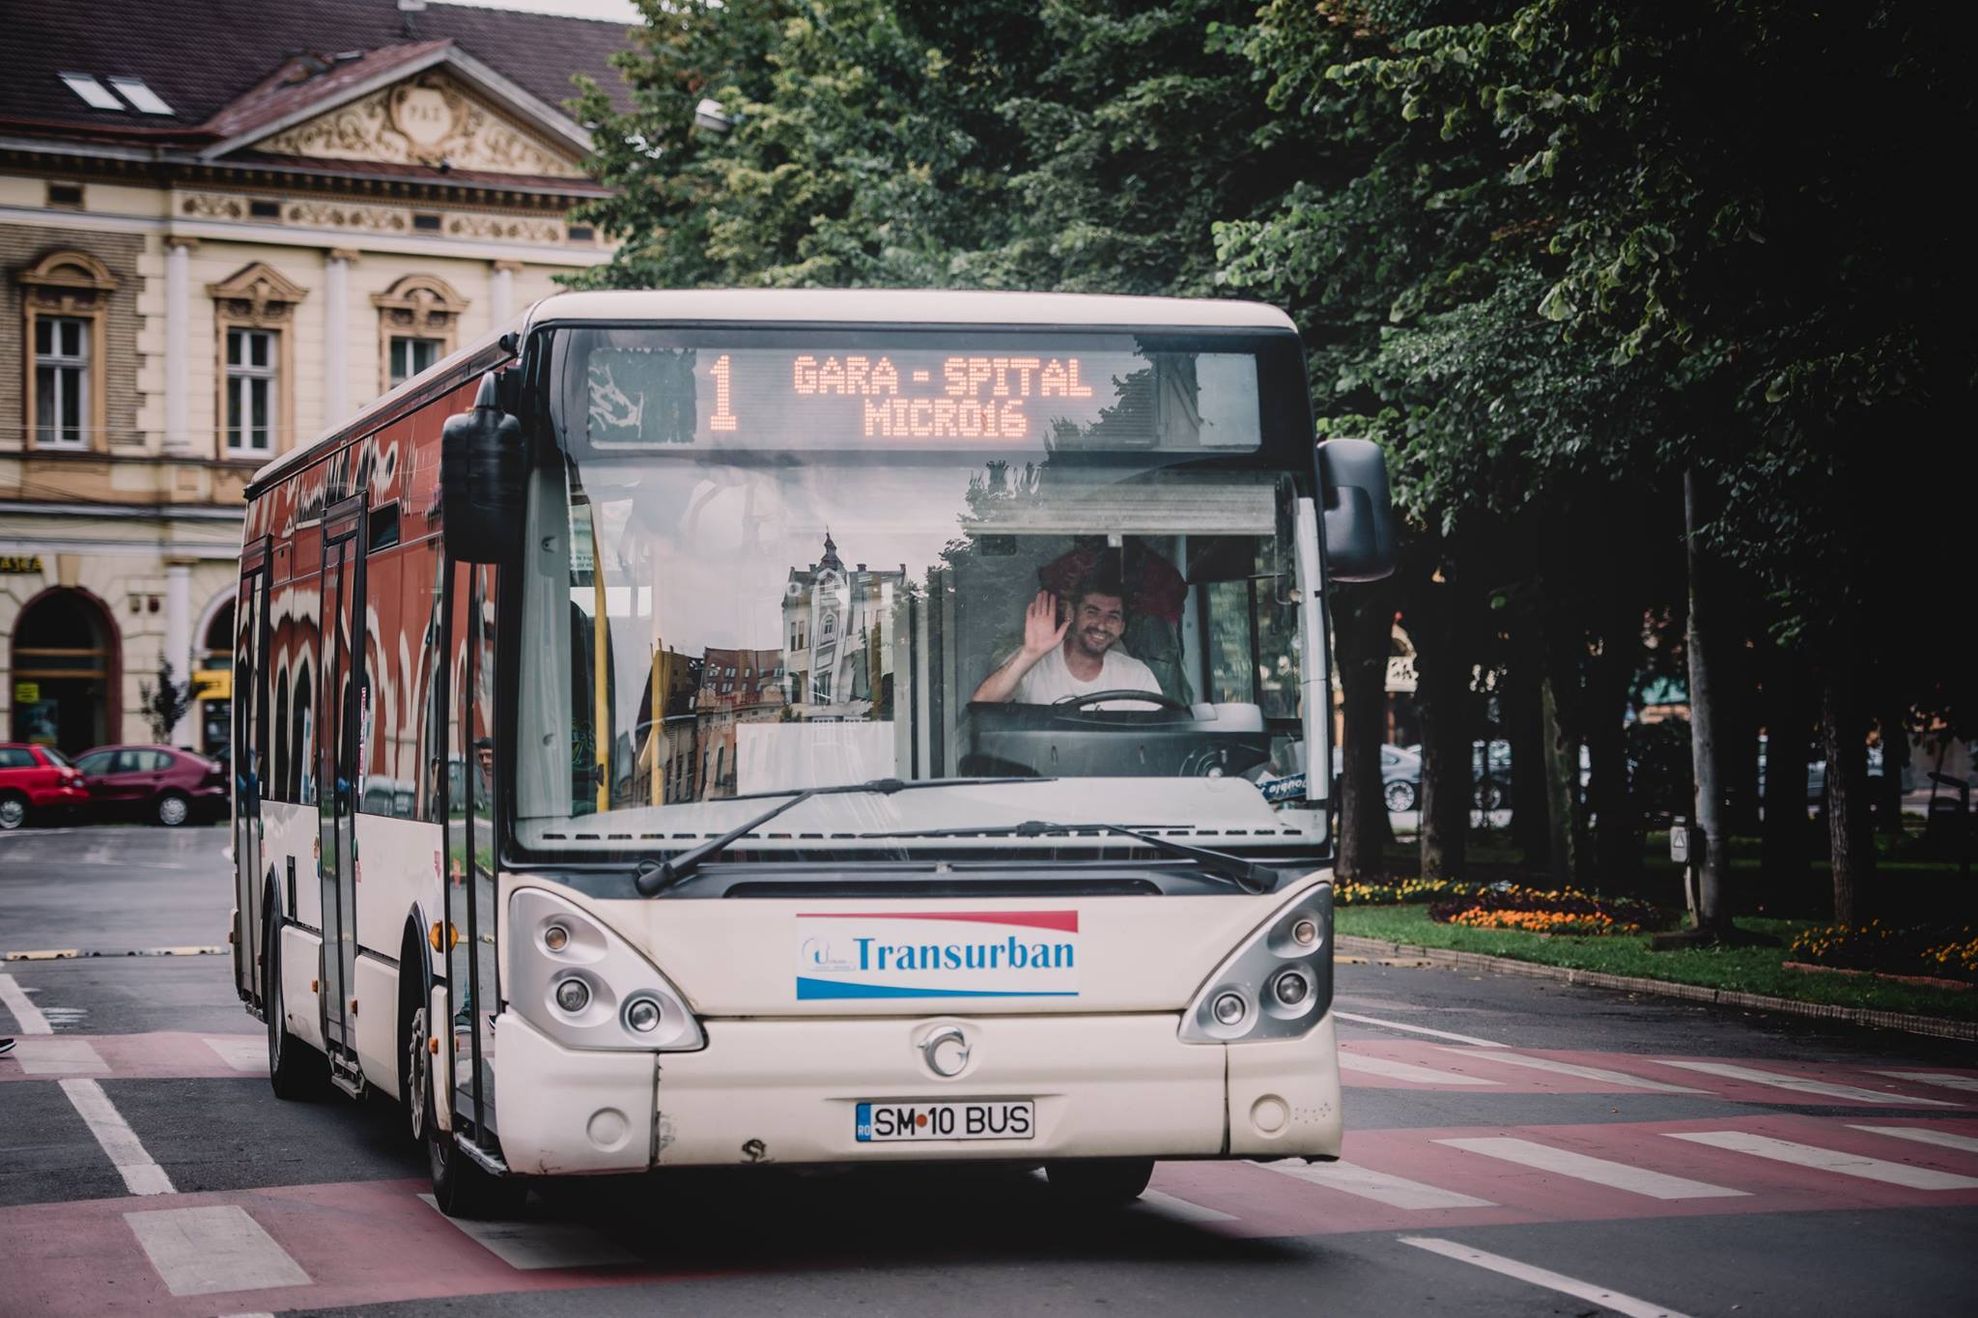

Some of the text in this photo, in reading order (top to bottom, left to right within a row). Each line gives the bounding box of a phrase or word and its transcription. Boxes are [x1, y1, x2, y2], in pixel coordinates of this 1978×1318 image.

[709, 354, 737, 432] 1
[794, 356, 1092, 397] GARA - SPITAL
[853, 936, 1074, 970] Transurban
[858, 1124, 870, 1136] RO
[875, 1106, 1029, 1136] SM 10 BUS
